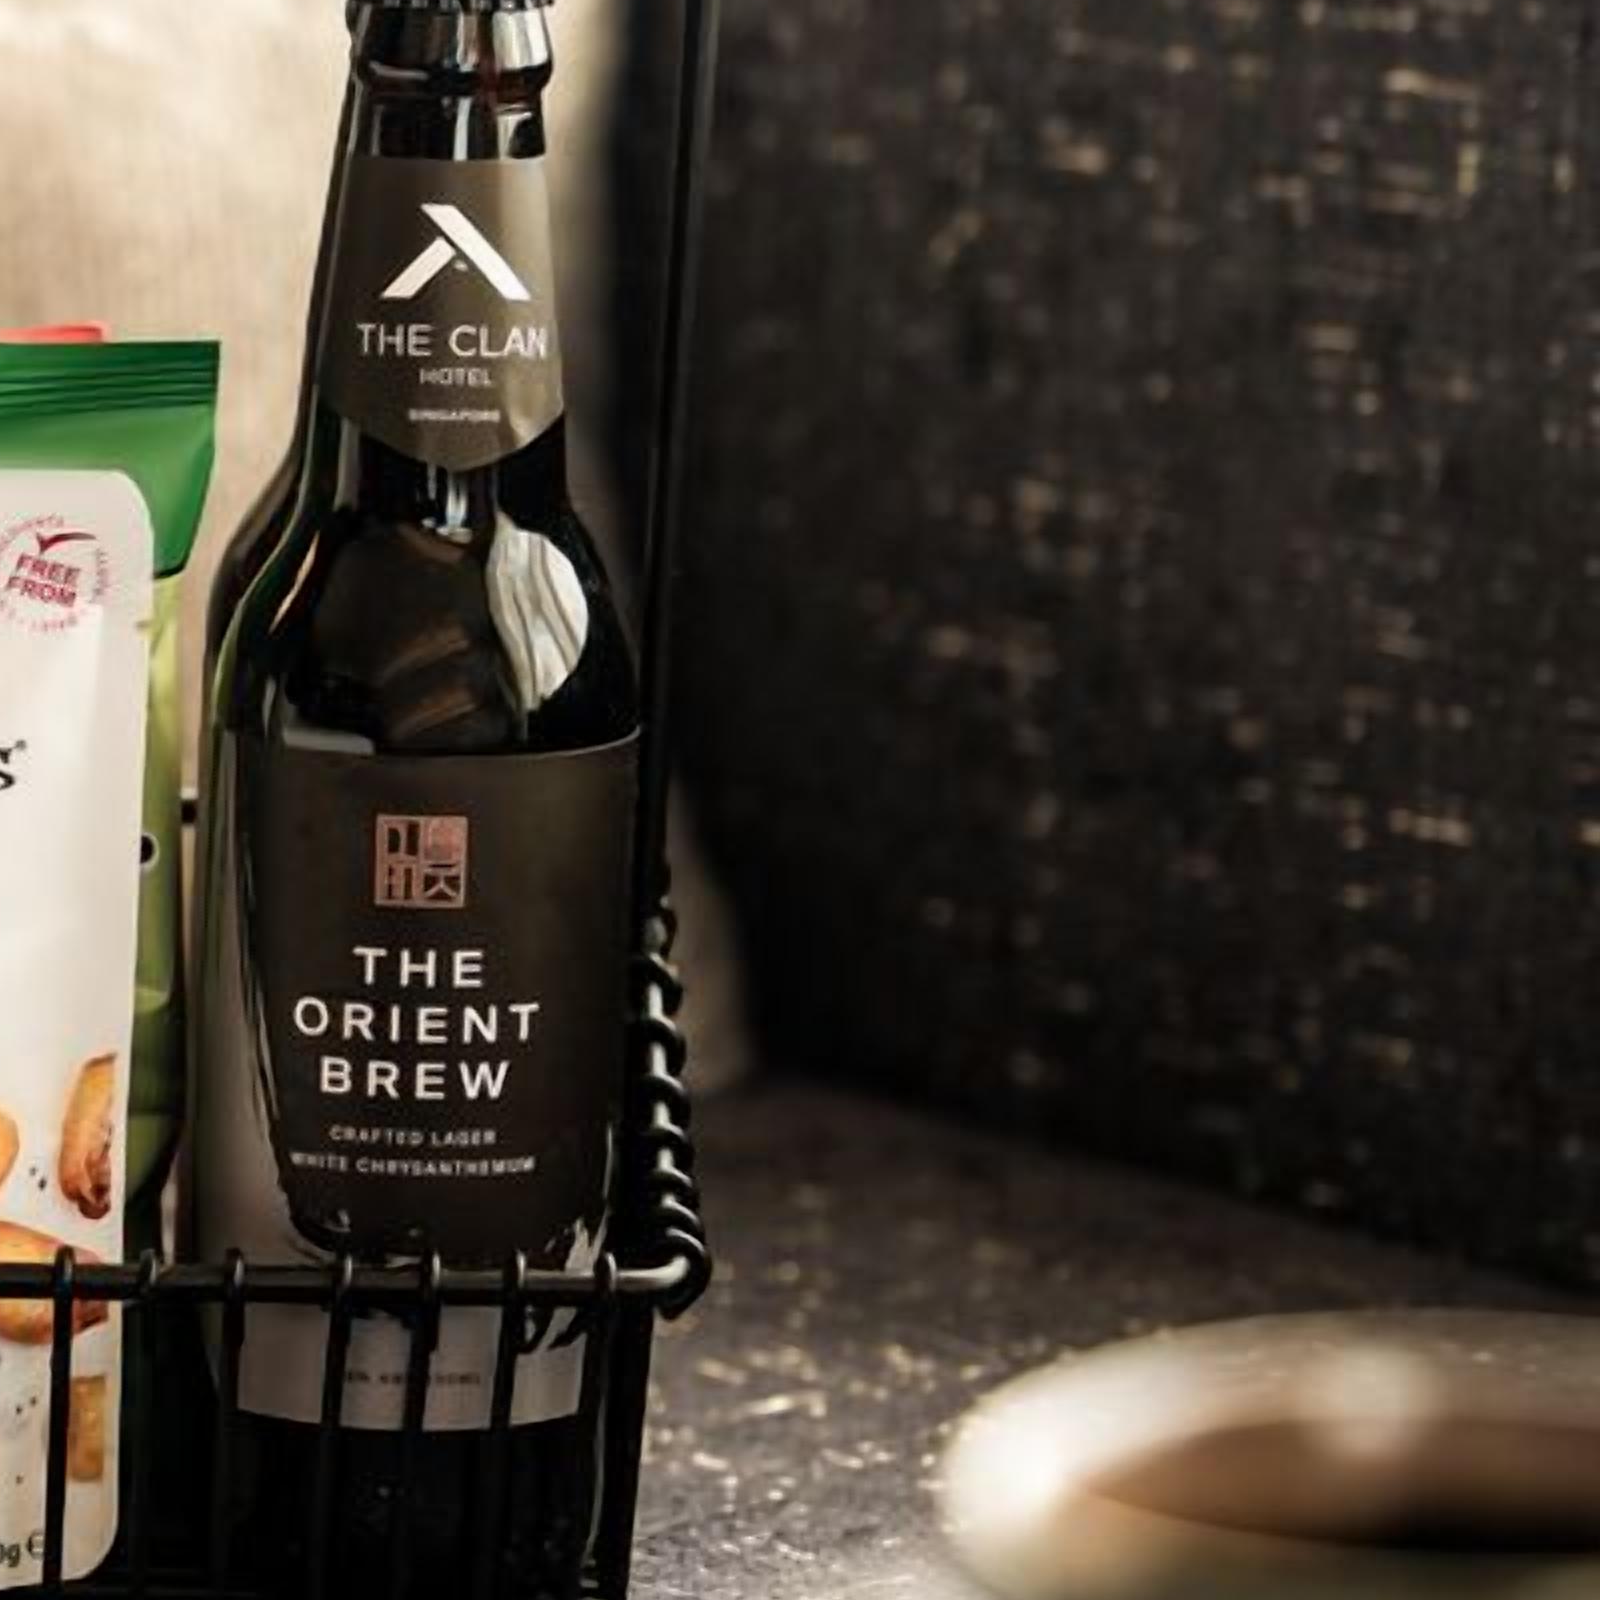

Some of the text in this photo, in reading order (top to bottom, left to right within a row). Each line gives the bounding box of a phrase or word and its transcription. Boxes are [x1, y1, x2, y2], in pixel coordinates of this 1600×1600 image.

[356, 323, 547, 360] THE CLAN
[419, 367, 493, 387] HOTEL
[14, 552, 82, 586] FREE
[3, 575, 77, 608] FROM
[352, 946, 484, 989] THE
[293, 996, 540, 1045] ORIENT
[320, 1055, 510, 1100] BREW
[329, 1124, 498, 1147] CRAFTED LAGER
